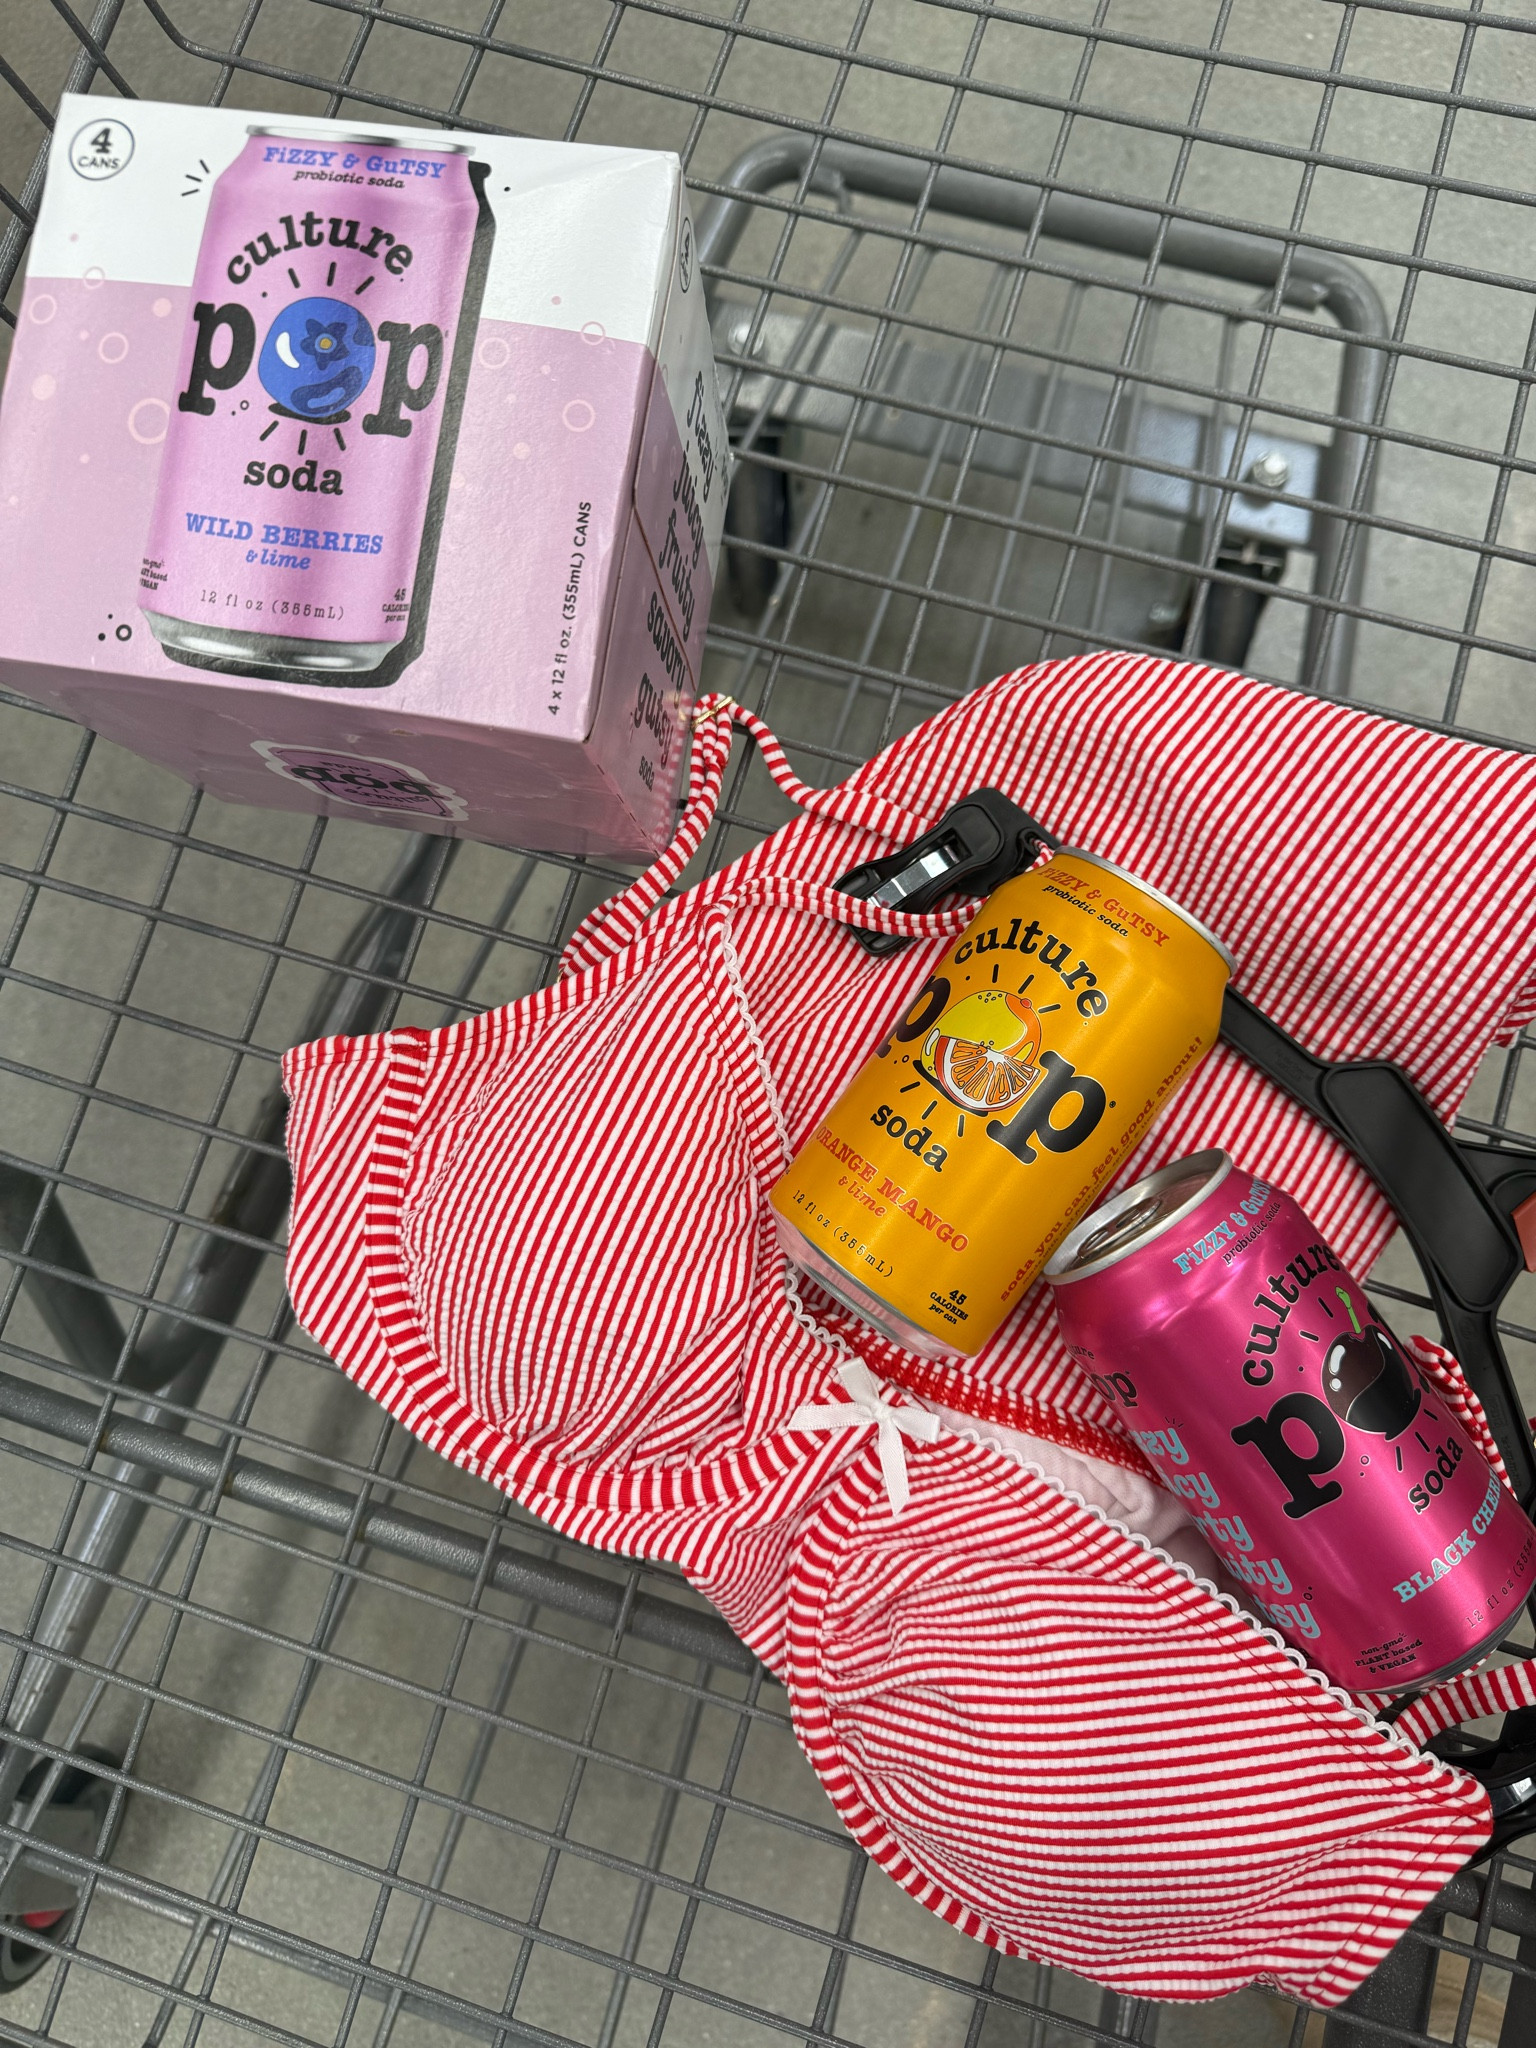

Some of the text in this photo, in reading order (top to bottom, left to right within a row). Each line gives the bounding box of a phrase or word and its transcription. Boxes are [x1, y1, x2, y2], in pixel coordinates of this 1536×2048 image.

[77, 155, 121, 171] CANS
[90, 127, 113, 154] 4
[262, 146, 447, 179] FiZZY & GuTSY
[293, 167, 406, 190] probiotic soda
[226, 210, 415, 286] culture
[686, 371, 715, 502] fizzy
[243, 459, 344, 496] soda
[673, 440, 704, 570] juicy
[185, 512, 384, 555] WILD BERRIES
[245, 549, 312, 571] & lime
[659, 508, 695, 642] fruity
[200, 589, 346, 621] 12 fl oz (355mL)
[393, 588, 407, 601] 45
[548, 501, 591, 715] 4 x 12 fl oz. (355mL) CANS
[647, 591, 688, 709] savory
[634, 672, 674, 769] gutsy
[291, 765, 450, 800] pop
[639, 755, 655, 792] soda
[1037, 867, 1170, 947] FiZZY & GuTSY
[1042, 885, 1128, 937] probiotic soda
[954, 918, 1109, 1019] culture
[870, 1104, 949, 1173] soda
[816, 1126, 969, 1252] ORANGE MANGO
[1000, 1036, 1203, 1301] soda you can feel good about!
[838, 1175, 888, 1218] & lime
[792, 1190, 894, 1277] 12 fl oz (355mL)
[1173, 1221, 1236, 1275] FiZZY
[1230, 1212, 1248, 1226] &
[1222, 1202, 1280, 1267] probiotic soda
[928, 1303, 957, 1324] per can
[930, 1291, 969, 1320] CALORIES
[949, 1290, 967, 1305] 45
[1241, 1243, 1343, 1387] culture
[1128, 1427, 1190, 1465] zzy
[1156, 1464, 1220, 1508] icy
[1408, 1436, 1464, 1515] soda
[1393, 1529, 1476, 1603] BLACK
[1253, 1594, 1321, 1639] tsy
[1465, 1610, 1484, 1628] 12
[1486, 1594, 1500, 1610] fl
[1501, 1579, 1514, 1596] oz
[1354, 1638, 1423, 1666] PLANT based
[1361, 1637, 1404, 1656] non-gmo
[1377, 1653, 1417, 1671] VEGAN
